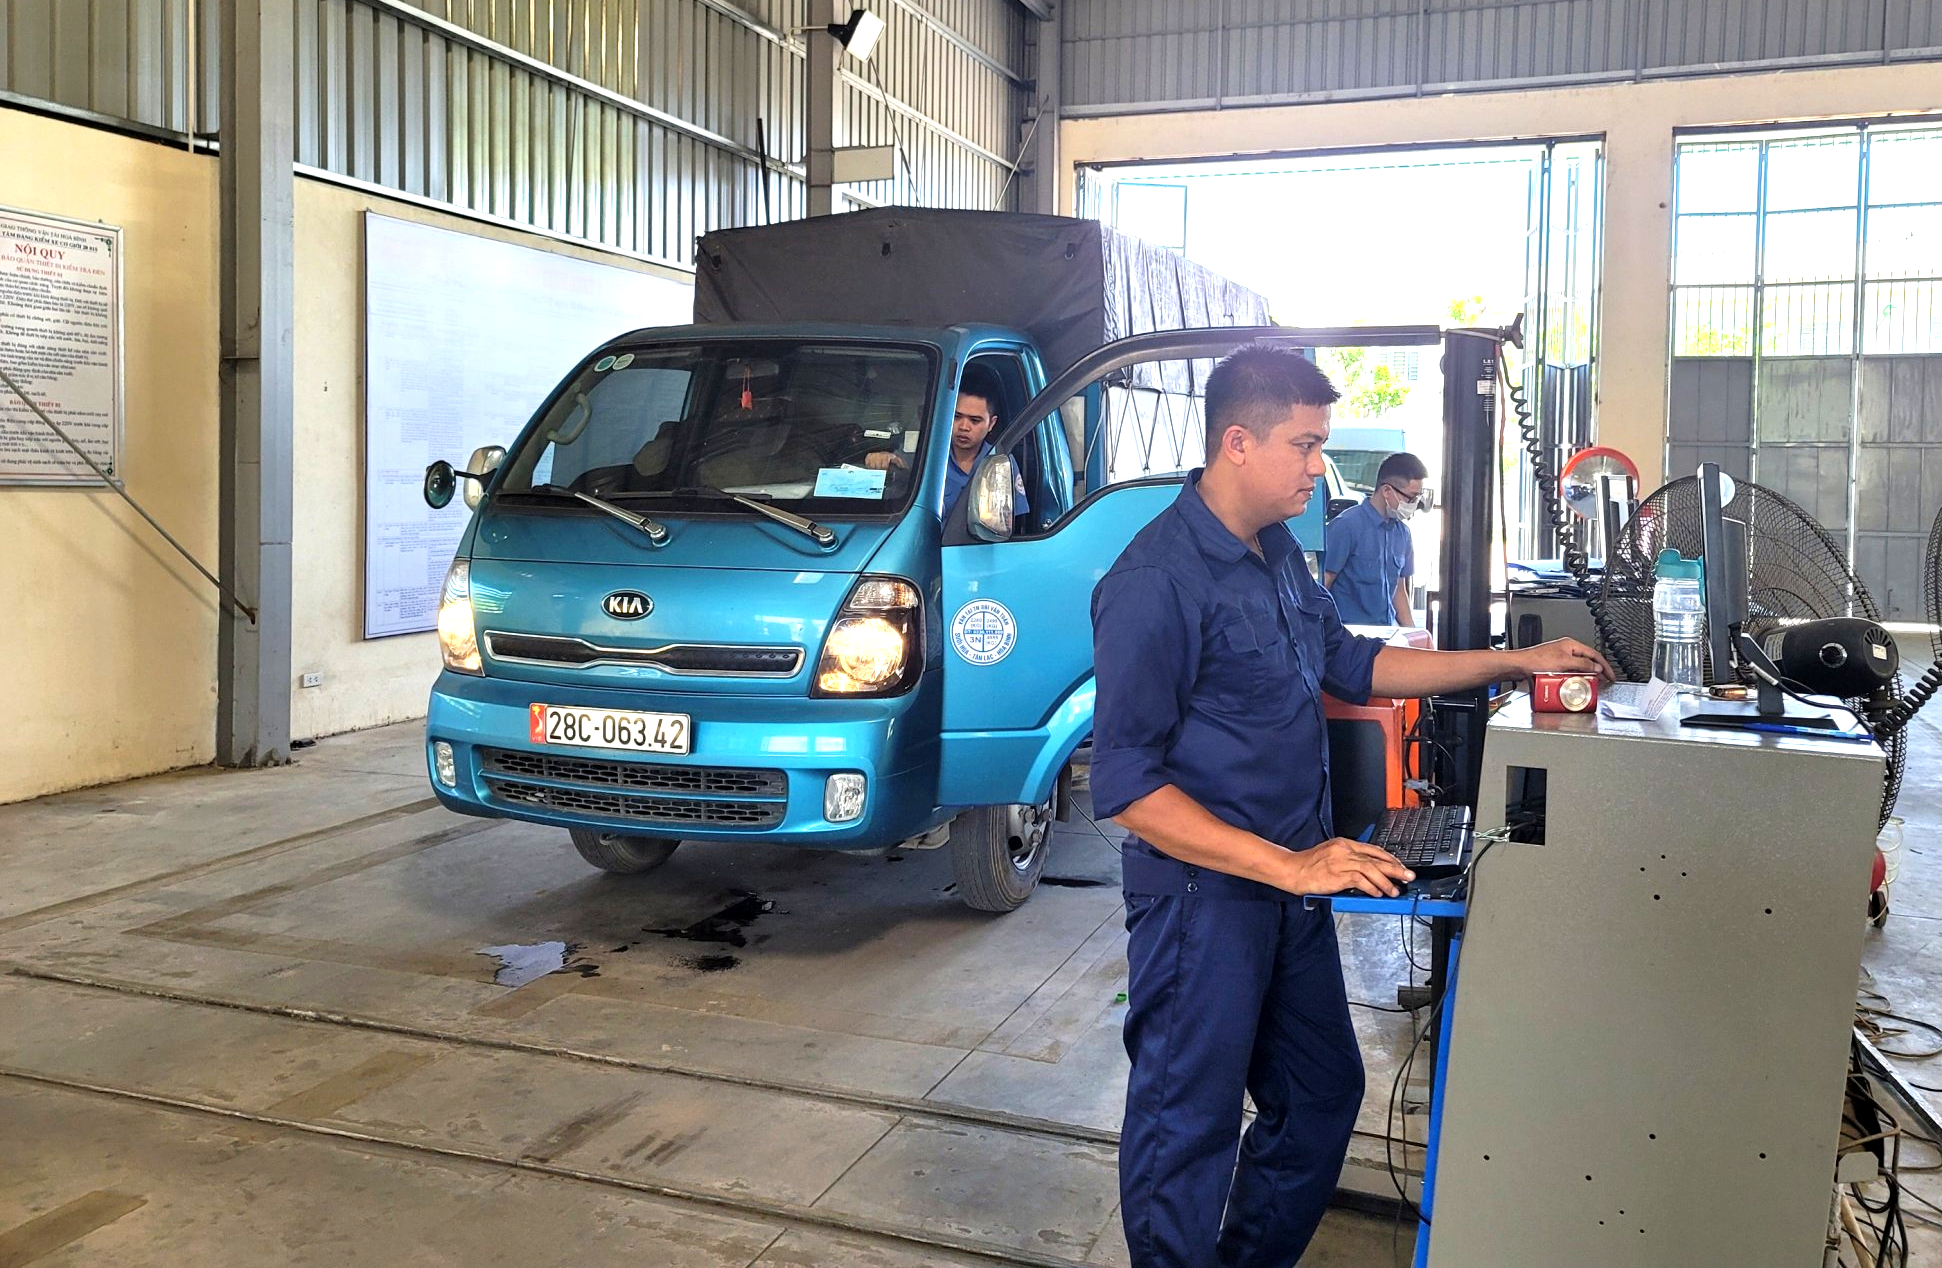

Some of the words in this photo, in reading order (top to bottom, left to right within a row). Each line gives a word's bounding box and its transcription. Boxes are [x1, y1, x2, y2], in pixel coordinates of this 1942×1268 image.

[15, 243, 36, 256] NỘI
[40, 248, 65, 260] QUY
[608, 596, 643, 613] KIA
[549, 711, 684, 750] 28C-063.42
